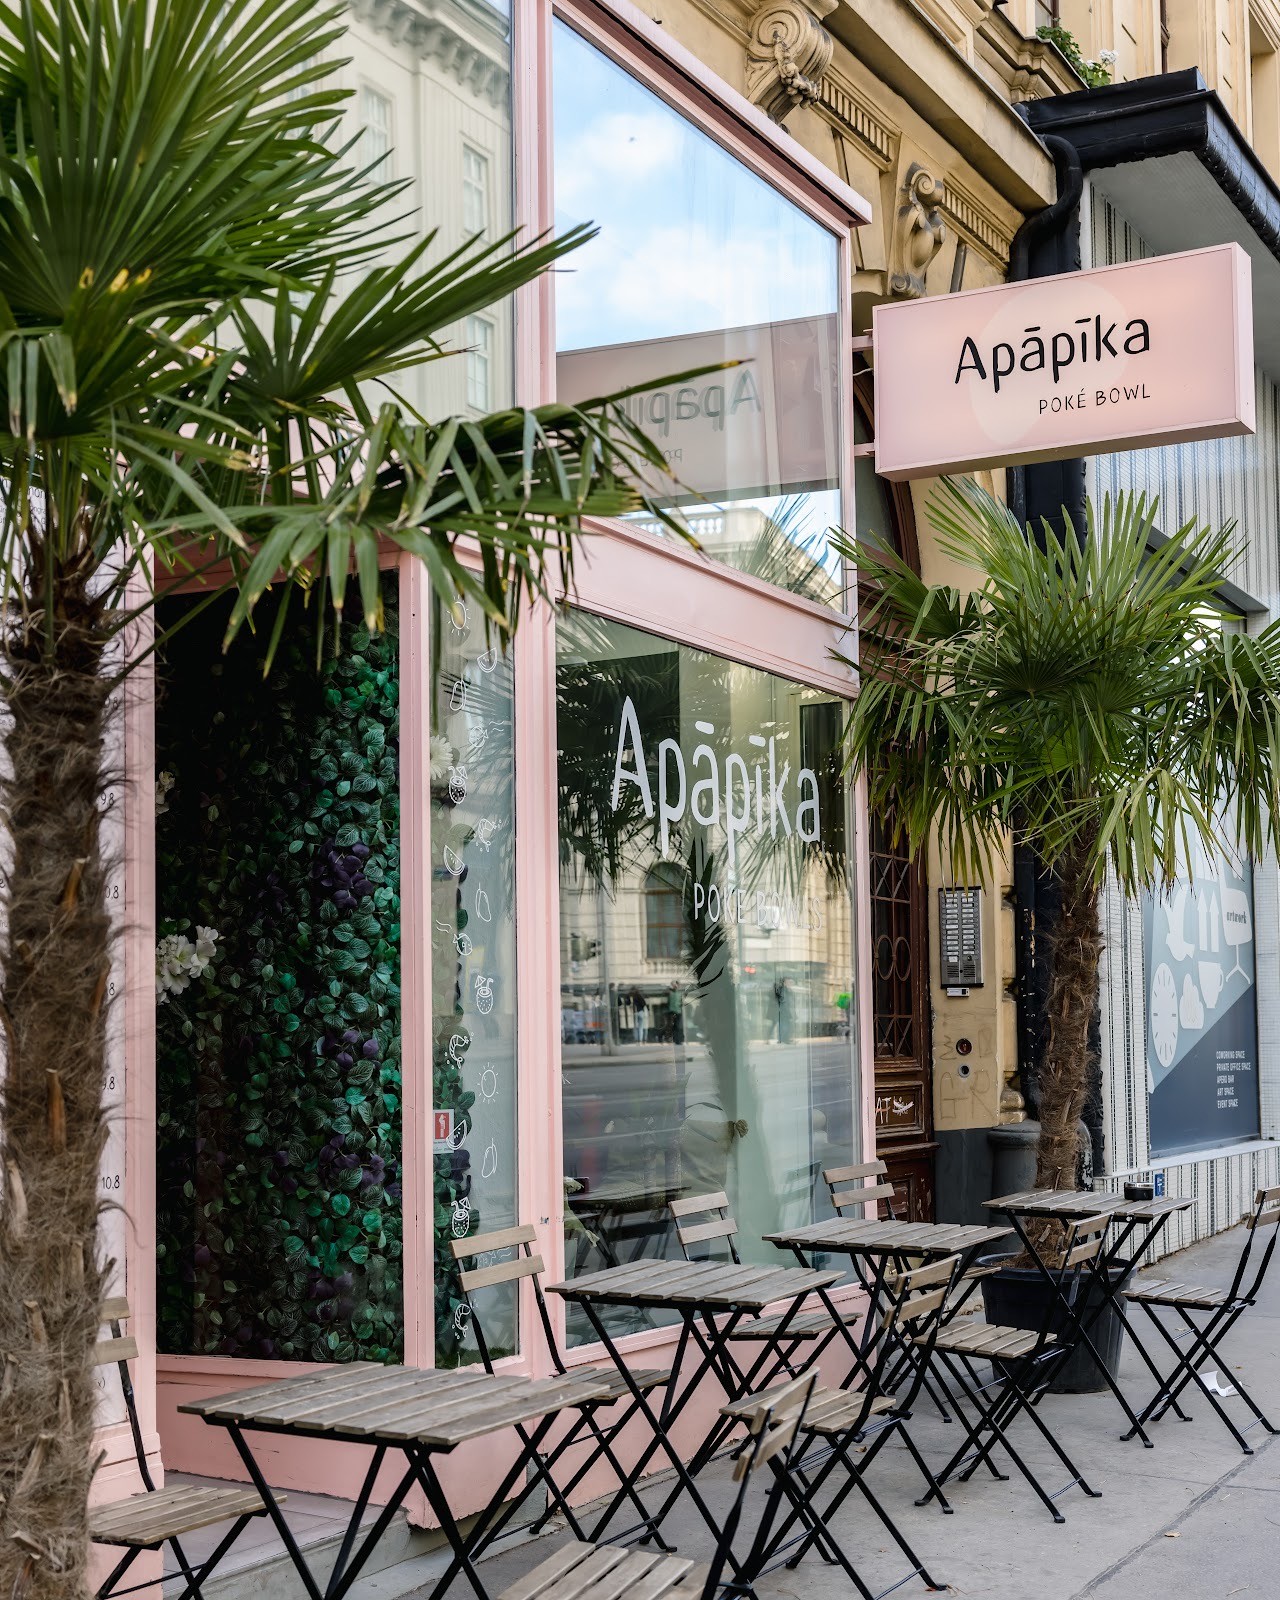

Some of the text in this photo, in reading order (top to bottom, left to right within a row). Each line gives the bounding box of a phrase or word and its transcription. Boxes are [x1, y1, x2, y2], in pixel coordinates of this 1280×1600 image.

[954, 314, 1151, 393] Apāpīka
[1039, 384, 1151, 414] POKÉ BOWL
[611, 695, 821, 873] Apāpīka
[1235, 1050, 1245, 1059] SPACE
[1216, 1062, 1251, 1071] PRIVATE OFFICE SPACE
[1224, 1087, 1234, 1096] SPACE
[1217, 1098, 1238, 1109] EVENT SPACE
